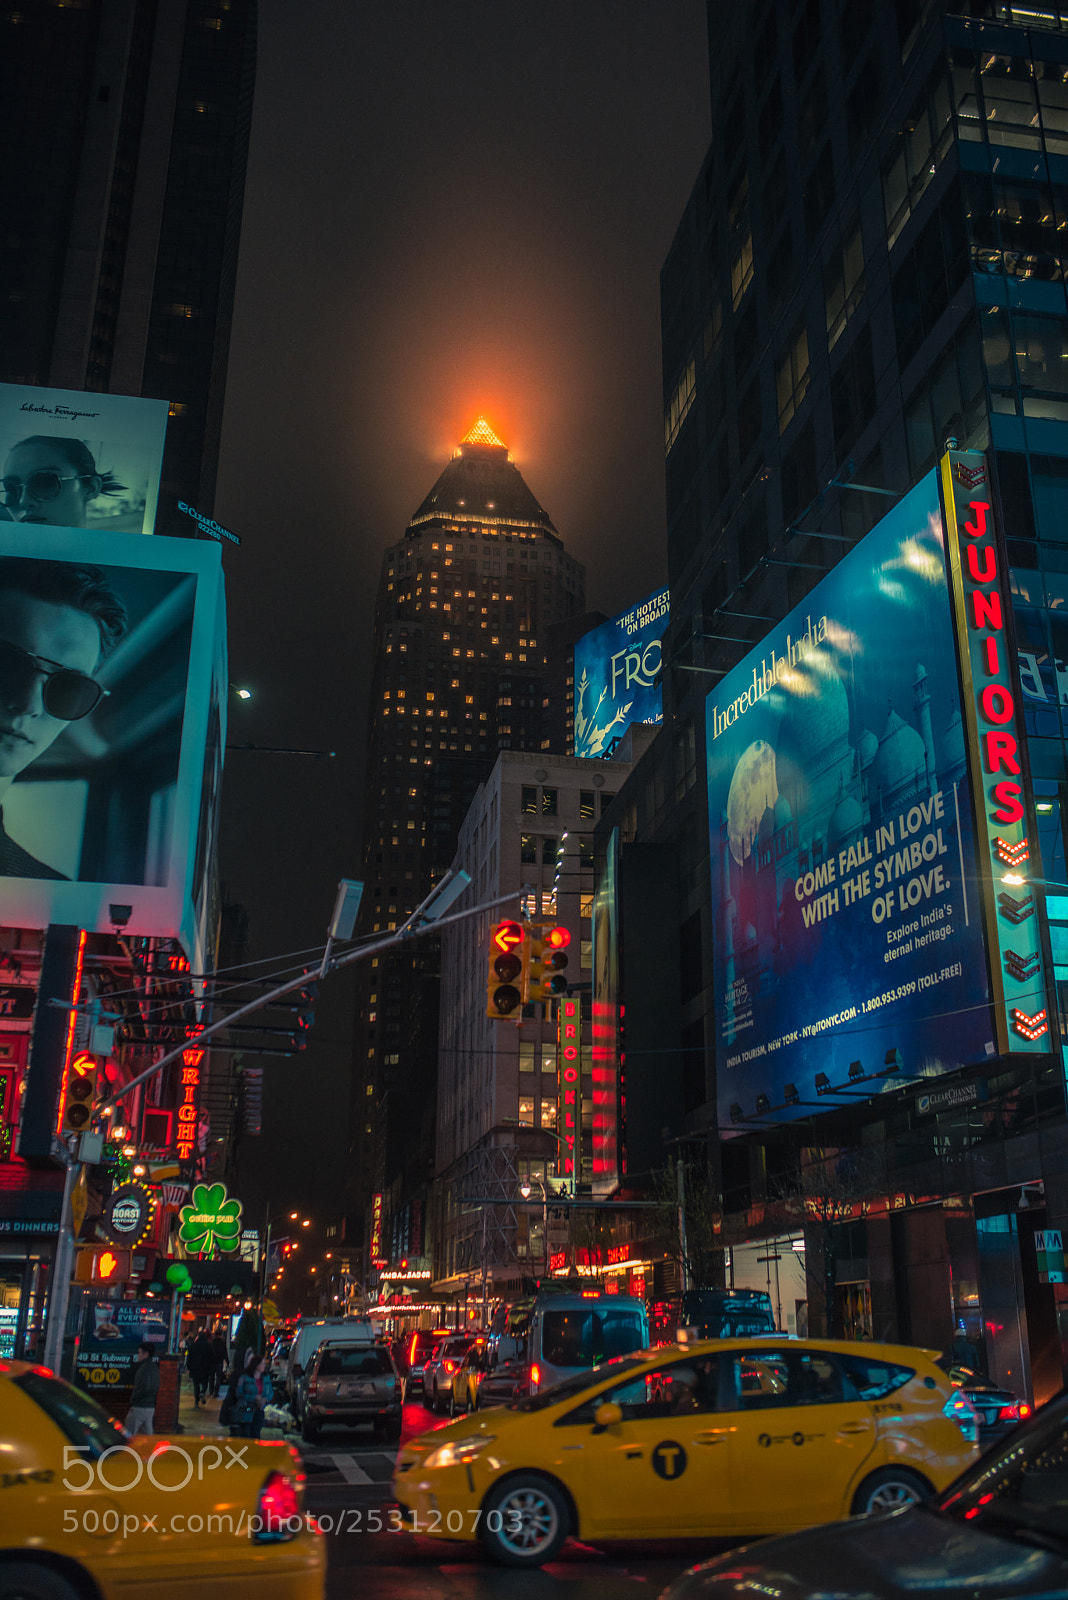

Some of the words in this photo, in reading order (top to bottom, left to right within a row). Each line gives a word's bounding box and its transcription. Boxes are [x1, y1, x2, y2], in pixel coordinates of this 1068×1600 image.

[54, 405, 101, 421] Ferragamo
[627, 621, 638, 635] ON
[636, 590, 670, 620] HOTTEST
[610, 639, 663, 700] FRO
[712, 649, 784, 741] Incredible
[786, 614, 828, 668] India
[961, 500, 1025, 824] JUNIORS
[794, 857, 836, 902] COME
[838, 836, 873, 877] FALL
[875, 820, 896, 855] IN
[899, 790, 945, 840] LOVE
[801, 887, 840, 929] WITH
[842, 869, 871, 907] THE
[874, 827, 948, 889] SYMBOL
[871, 890, 895, 924] OF
[898, 864, 951, 912] LOVE.
[883, 939, 913, 963] eternal
[914, 924, 955, 949] heritage.
[886, 920, 920, 944] Explore
[920, 903, 953, 928] India's
[726, 1055, 742, 1069] INDIA
[767, 1037, 781, 1053] NEW
[781, 1030, 799, 1047] YORK
[917, 961, 962, 992] (TOLL-FREE)
[563, 1002, 578, 1174] BROOKLYN
[13, 1221, 59, 1232] DINNERS
[112, 1207, 141, 1219] ROAST
[77, 1352, 89, 1362] 49
[101, 1352, 130, 1363] Subway
